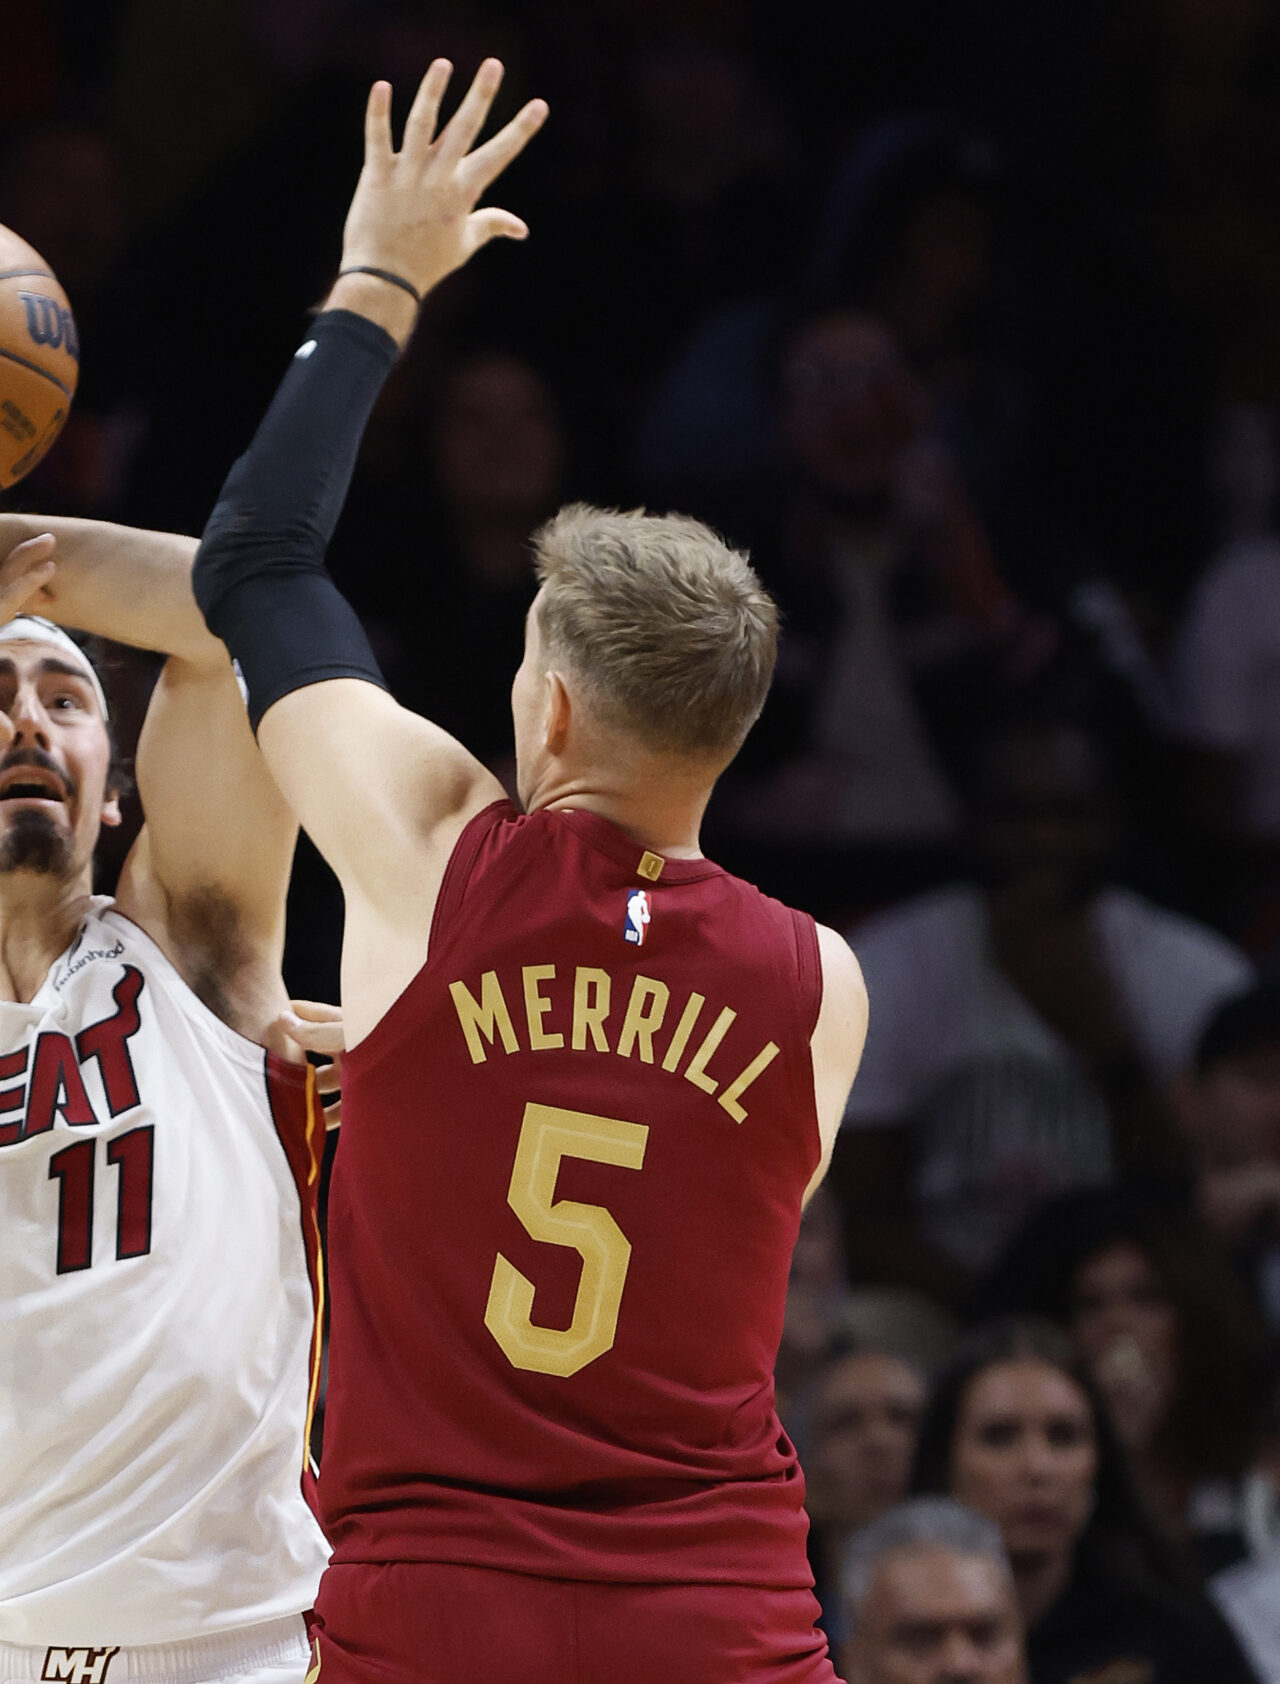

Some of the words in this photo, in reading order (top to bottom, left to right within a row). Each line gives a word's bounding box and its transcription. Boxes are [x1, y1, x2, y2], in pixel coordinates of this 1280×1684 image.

[449, 964, 780, 1124] MERRILL
[48, 1124, 155, 1275] 11
[484, 1102, 650, 1378] 5
